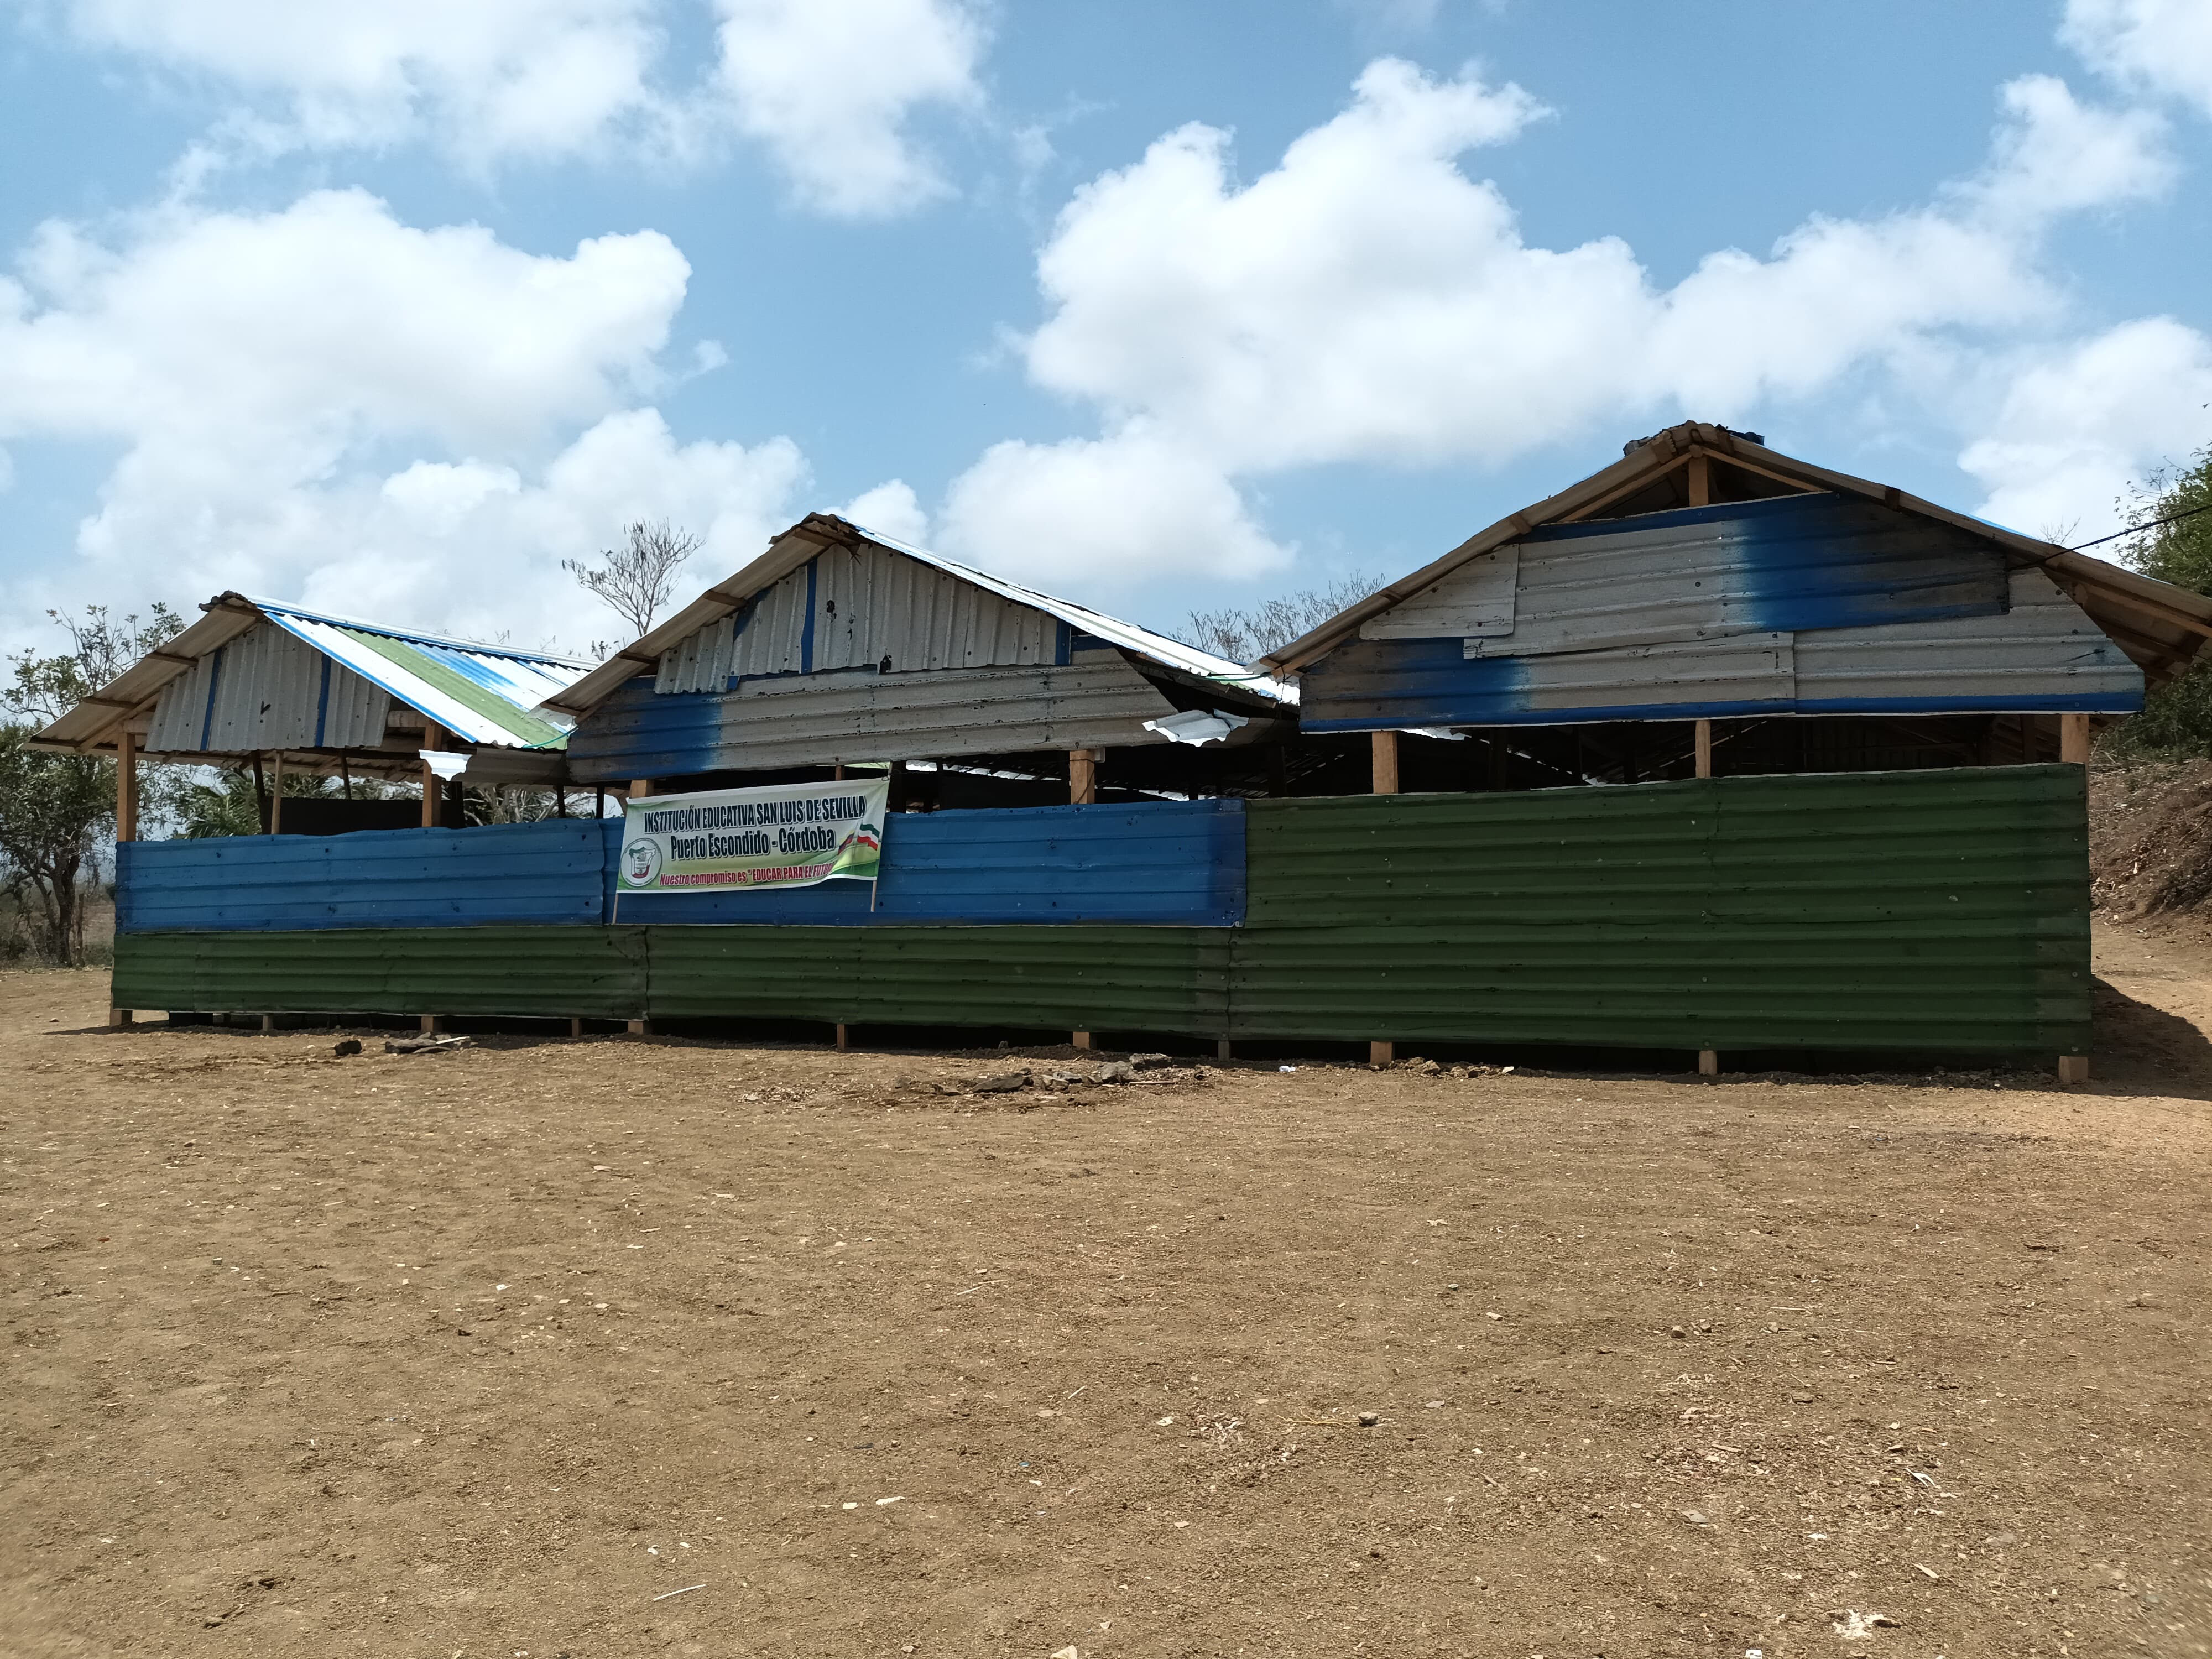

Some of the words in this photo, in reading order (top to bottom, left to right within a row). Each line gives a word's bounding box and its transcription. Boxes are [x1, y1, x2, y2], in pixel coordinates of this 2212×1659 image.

[644, 805, 700, 833] INSTITUCIÓN
[702, 804, 755, 828] EDUCATIVA
[757, 802, 778, 825] SAN
[780, 800, 803, 823] LUIS
[806, 799, 820, 821] DE
[822, 796, 866, 820] SEVILLA
[670, 836, 706, 859] Puerto
[708, 830, 769, 857] Escondido
[779, 826, 835, 853] Córdoba
[660, 873, 690, 886] Nuestro
[691, 870, 735, 885] compromiso
[737, 871, 746, 883] es
[784, 866, 802, 880] PARA
[805, 865, 812, 878] EL
[813, 862, 835, 877] FUTUR
